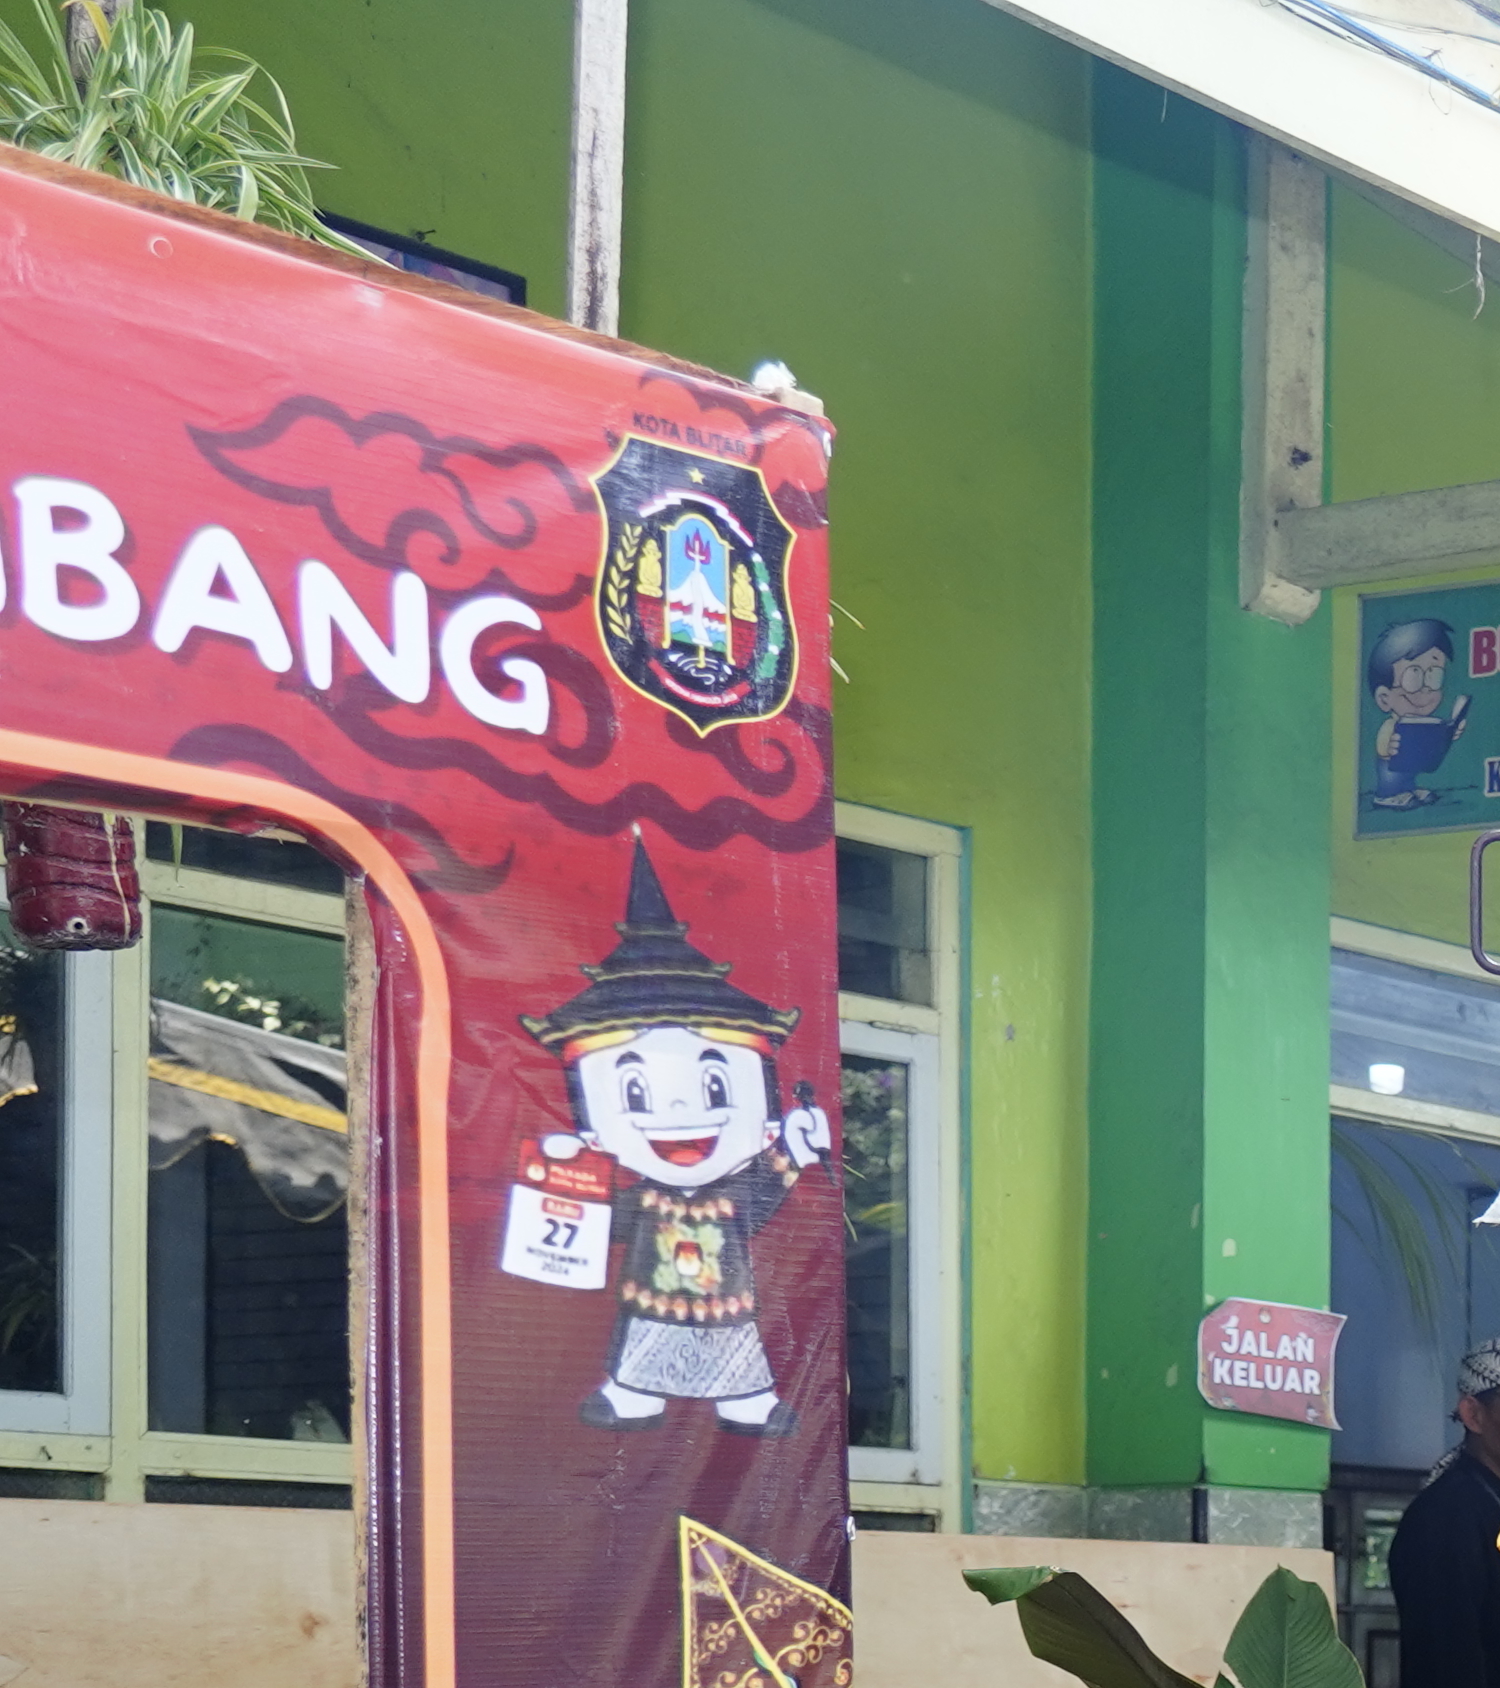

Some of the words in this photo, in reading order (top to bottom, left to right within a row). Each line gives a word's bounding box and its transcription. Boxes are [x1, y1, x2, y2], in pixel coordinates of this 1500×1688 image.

[633, 412, 681, 440] KOTA
[0, 474, 550, 736] BANG
[541, 1217, 579, 1249] 27
[1221, 1327, 1315, 1363] JALAN
[1212, 1357, 1322, 1396] KELUAR
